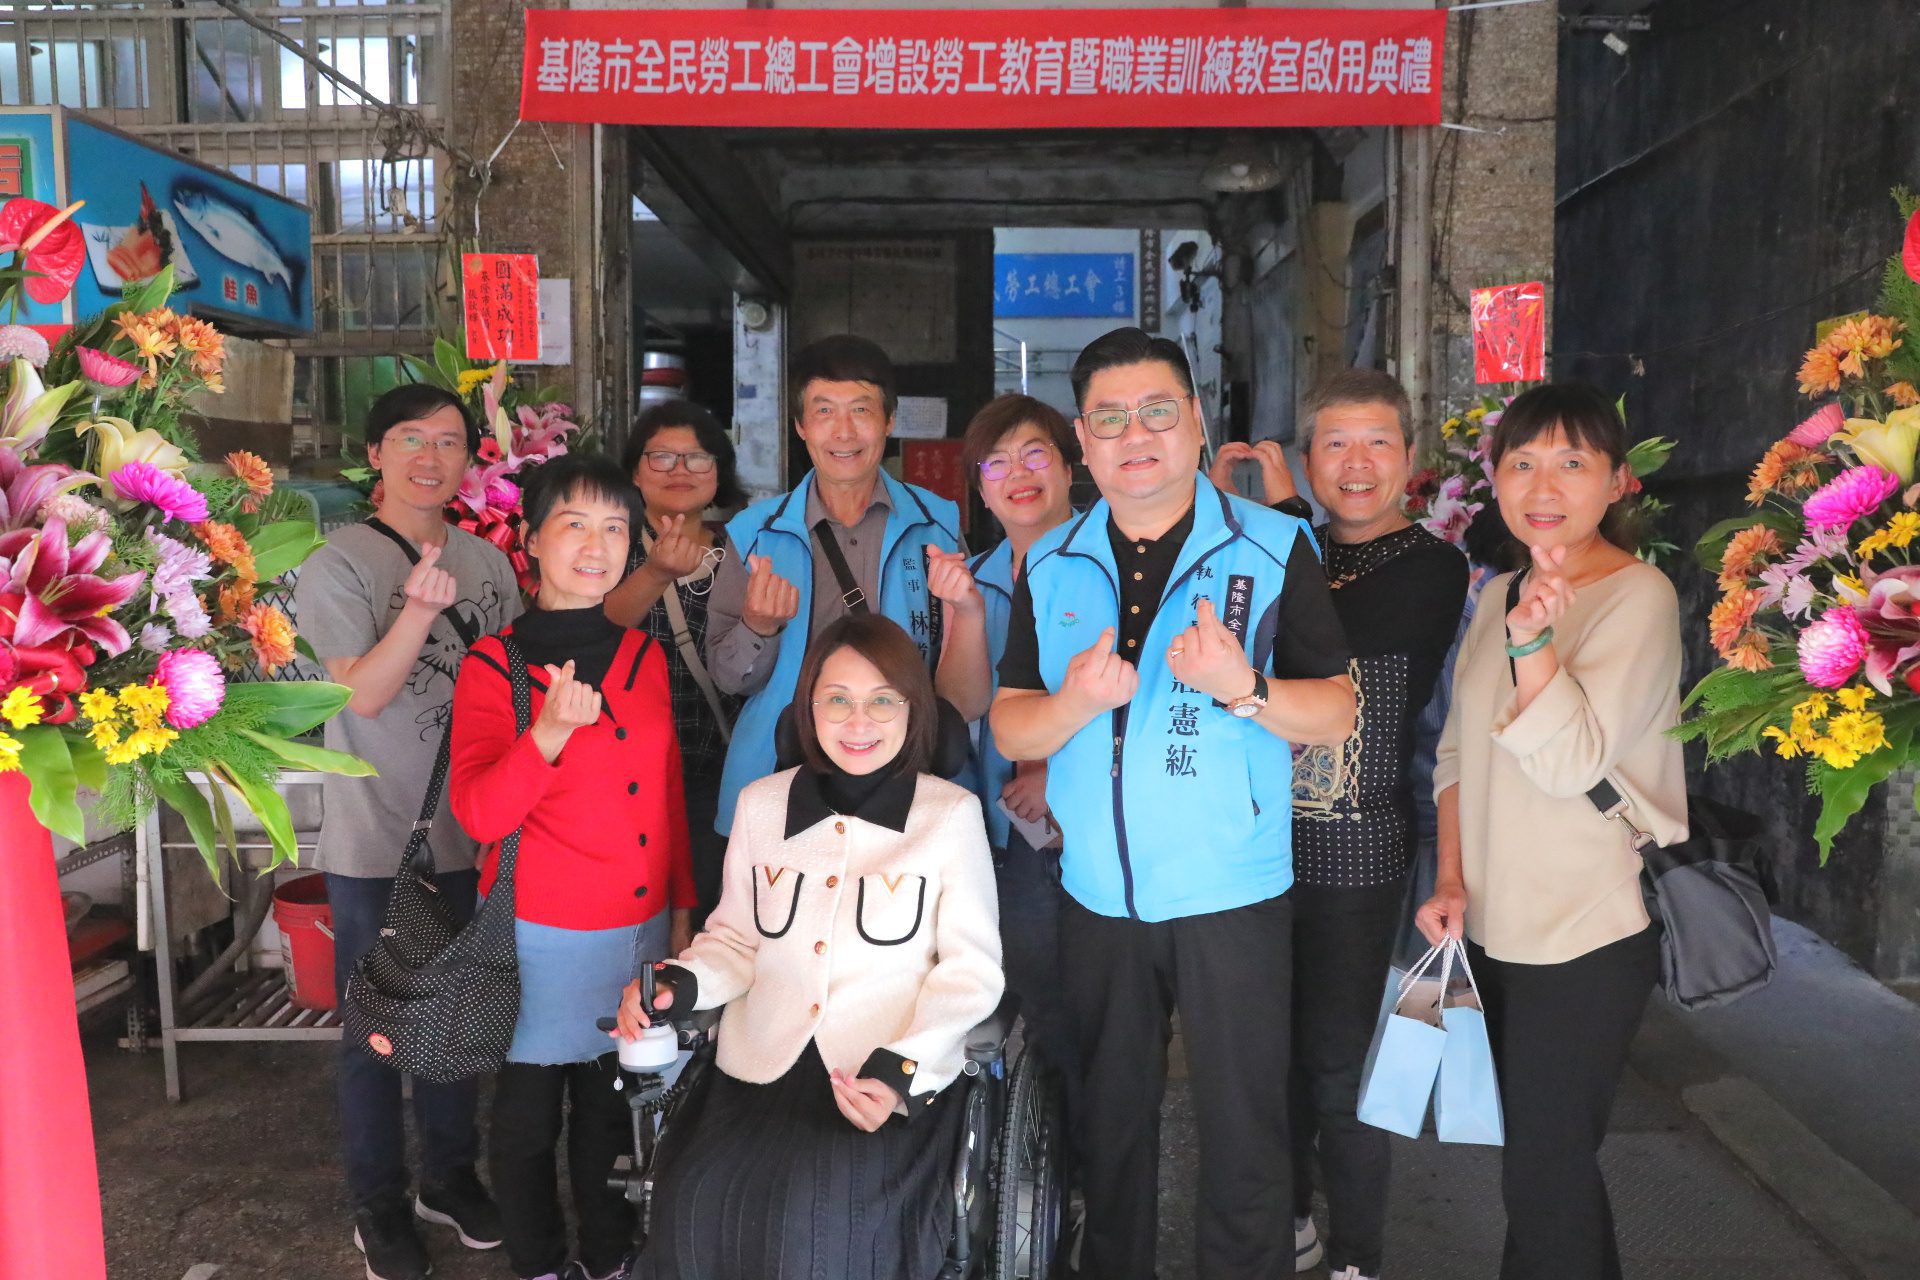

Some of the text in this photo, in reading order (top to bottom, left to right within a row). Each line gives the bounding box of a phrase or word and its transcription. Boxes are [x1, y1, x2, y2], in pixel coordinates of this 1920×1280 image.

[535, 37, 1433, 95] 基隆市全民勞工總工會增設勞工教育暨職業訓練教室啟用典禮
[223, 275, 258, 306] 鮭魚
[495, 260, 515, 343] 圓滿成功
[994, 268, 1102, 303] 勞工總工會
[903, 558, 920, 592] 監事
[1191, 564, 1214, 627] 執行
[1228, 578, 1248, 637] 基隆市全
